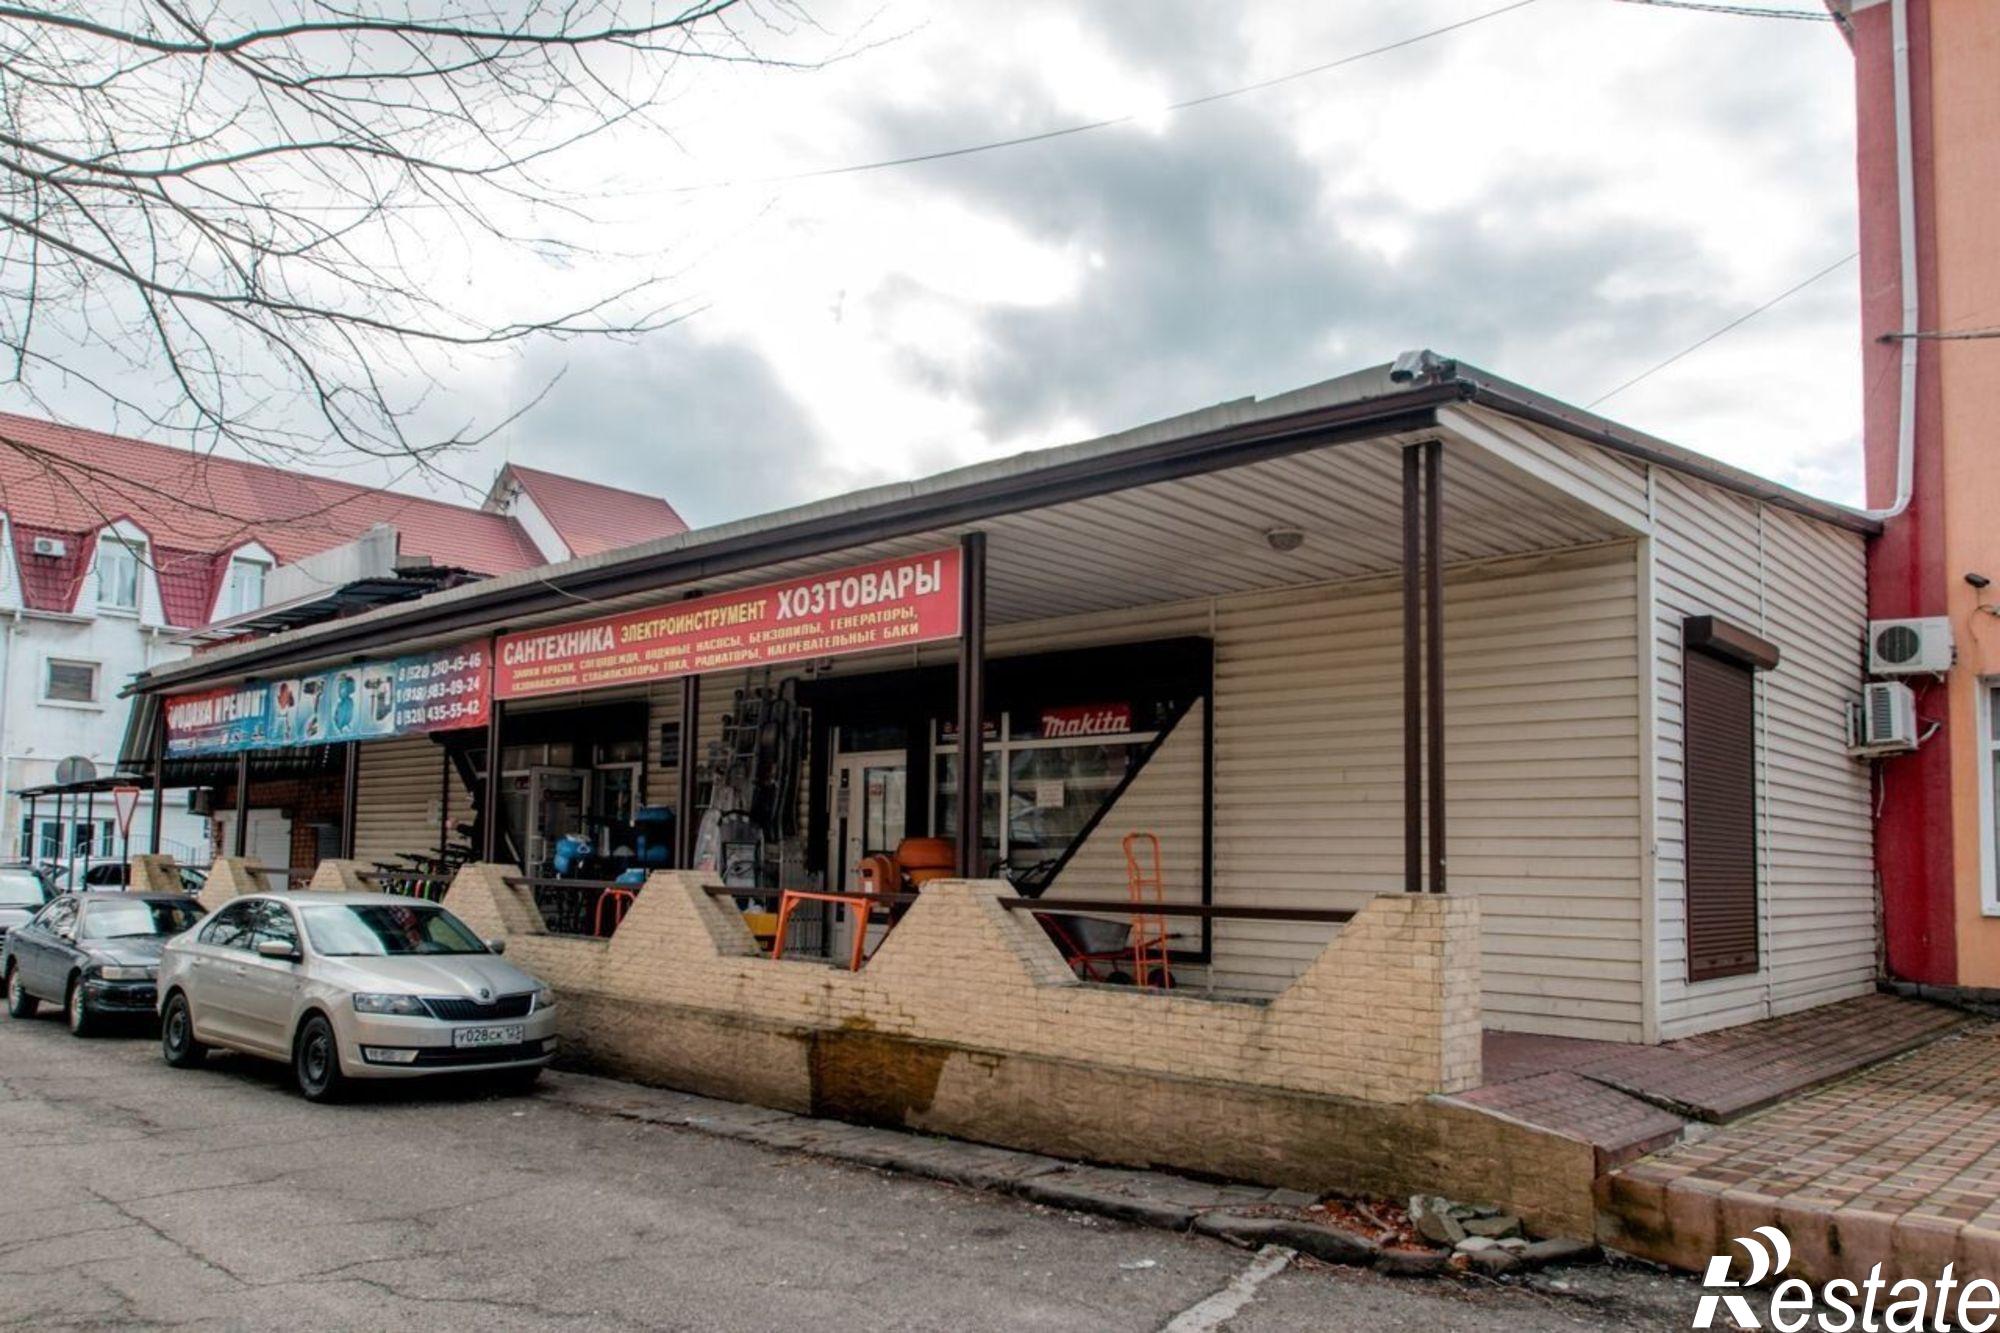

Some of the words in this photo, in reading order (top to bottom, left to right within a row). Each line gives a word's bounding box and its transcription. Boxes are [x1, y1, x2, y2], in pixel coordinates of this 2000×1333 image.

[504, 624, 615, 665] САНТЕХНИКА
[620, 599, 767, 644] ЭЛЕКТРОИНСТРУМЕНТ
[776, 560, 941, 620] ХОЗТОВАРЫ
[749, 620, 825, 644] БЕНЗОПИЛЫ,
[830, 605, 918, 631] ГЕНЕРАТОРЫ,
[694, 647, 763, 668] РАДИАТОРЫ,
[767, 629, 877, 657] НАГРЕВАТЕЛЬНЫЕ
[883, 622, 919, 640] БАКИ
[1042, 711, 1131, 738] Makita
